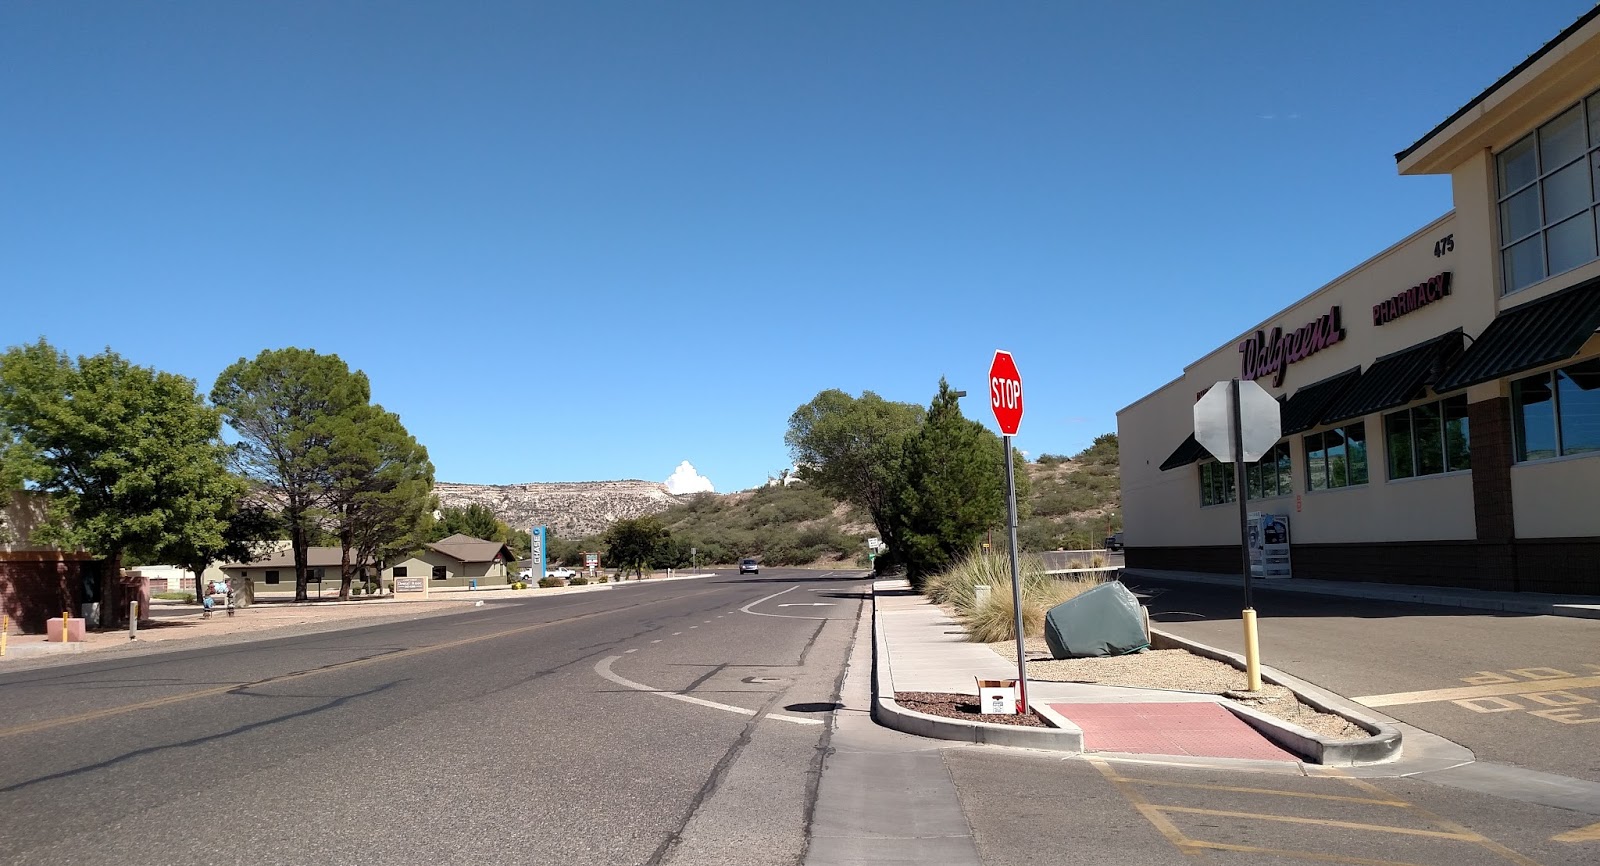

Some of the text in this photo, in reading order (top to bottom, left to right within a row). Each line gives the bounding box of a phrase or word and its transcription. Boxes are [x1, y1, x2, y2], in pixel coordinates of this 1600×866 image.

[1434, 234, 1454, 258] 475
[1373, 271, 1451, 326] PHARMACY
[1239, 306, 1346, 388] Walgreens
[991, 377, 1021, 409] STOP
[533, 535, 541, 564] CHASE
